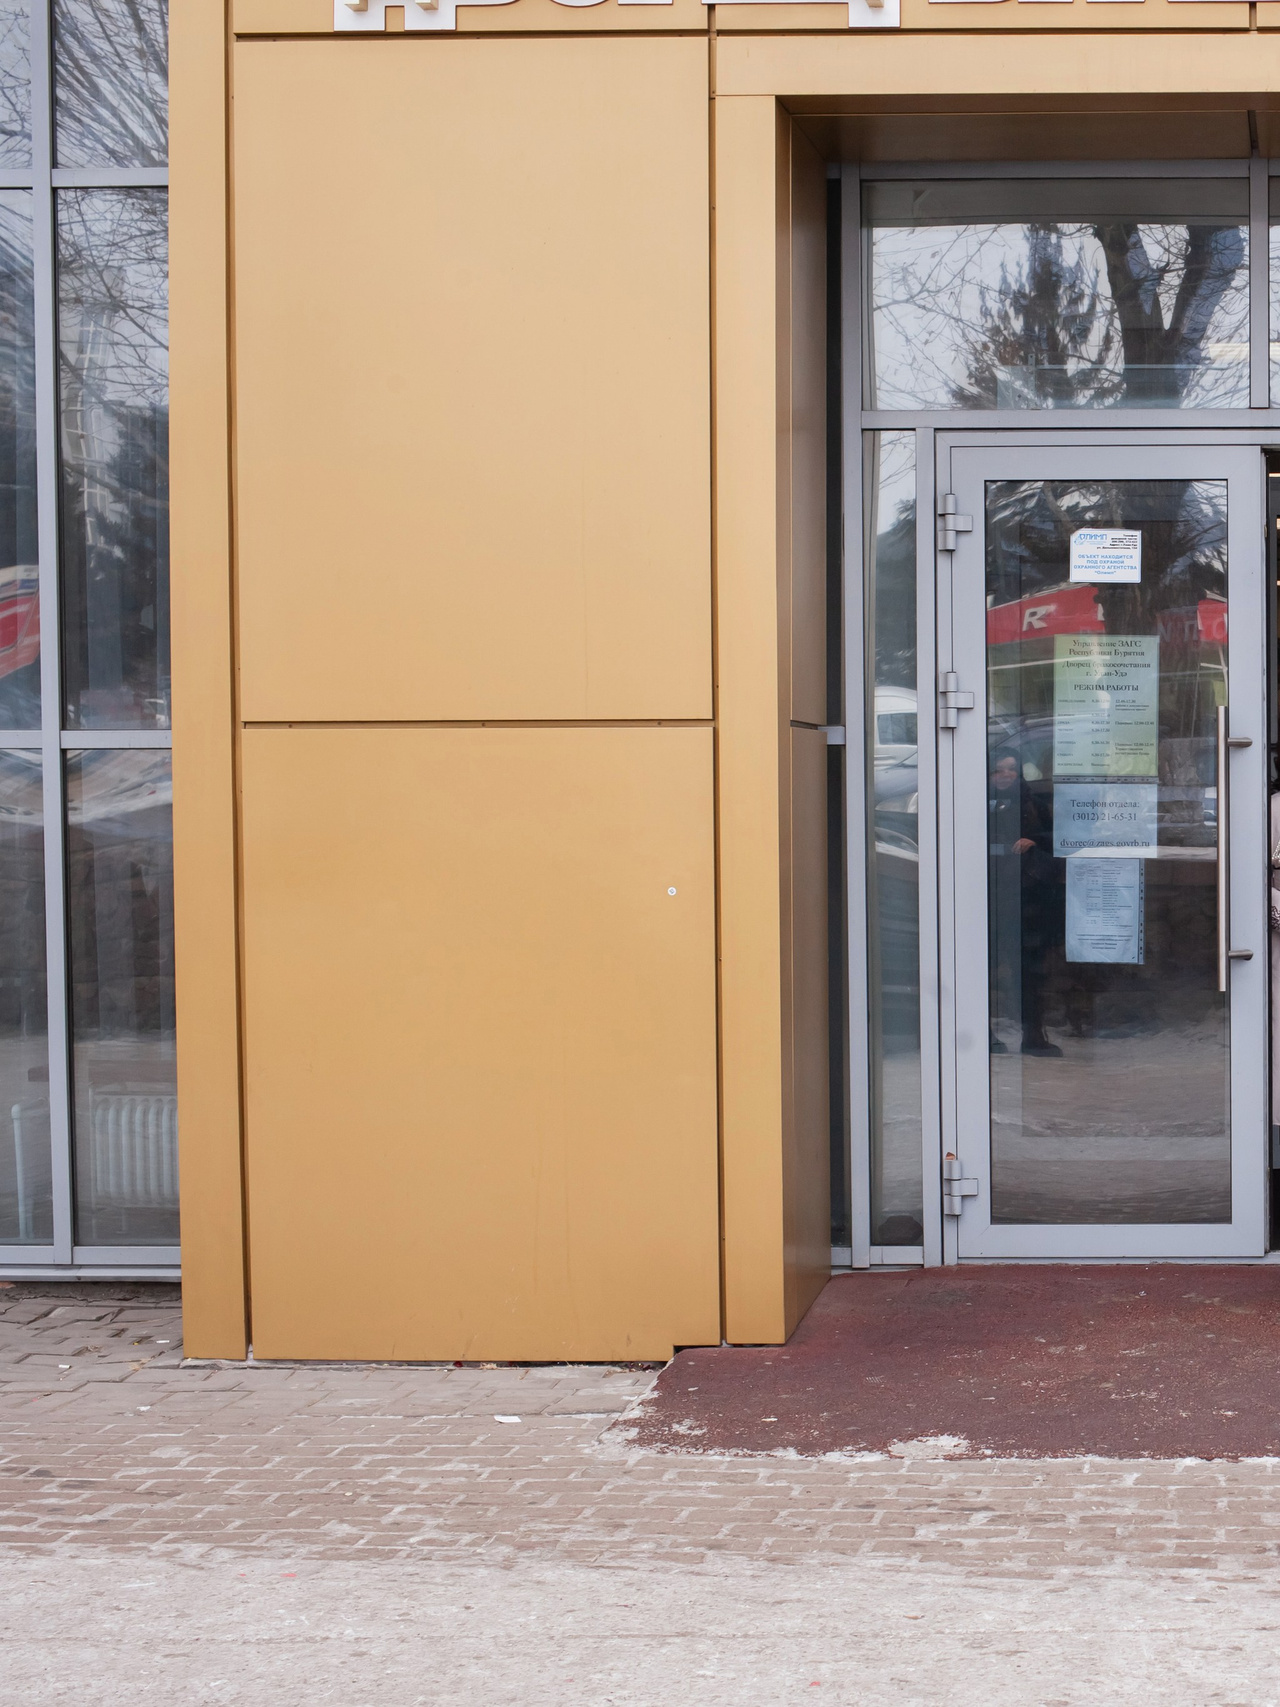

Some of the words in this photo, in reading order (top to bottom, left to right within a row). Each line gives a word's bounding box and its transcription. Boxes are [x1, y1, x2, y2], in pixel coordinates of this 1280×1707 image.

[1078, 533, 1107, 541] ОЛИМП
[1068, 648, 1112, 656] Респубики
[1113, 649, 1145, 657] Бурятия
[1062, 660, 1091, 669] Дворец
[1094, 669, 1128, 677] Уан-Удэ
[1070, 799, 1107, 810] Телефон
[1108, 800, 1140, 809] отдела:
[1072, 812, 1099, 822] (3012)
[1101, 812, 1137, 821] 21-65-31
[1060, 839, 1150, 849] dvorec@zags.govrb.ru
